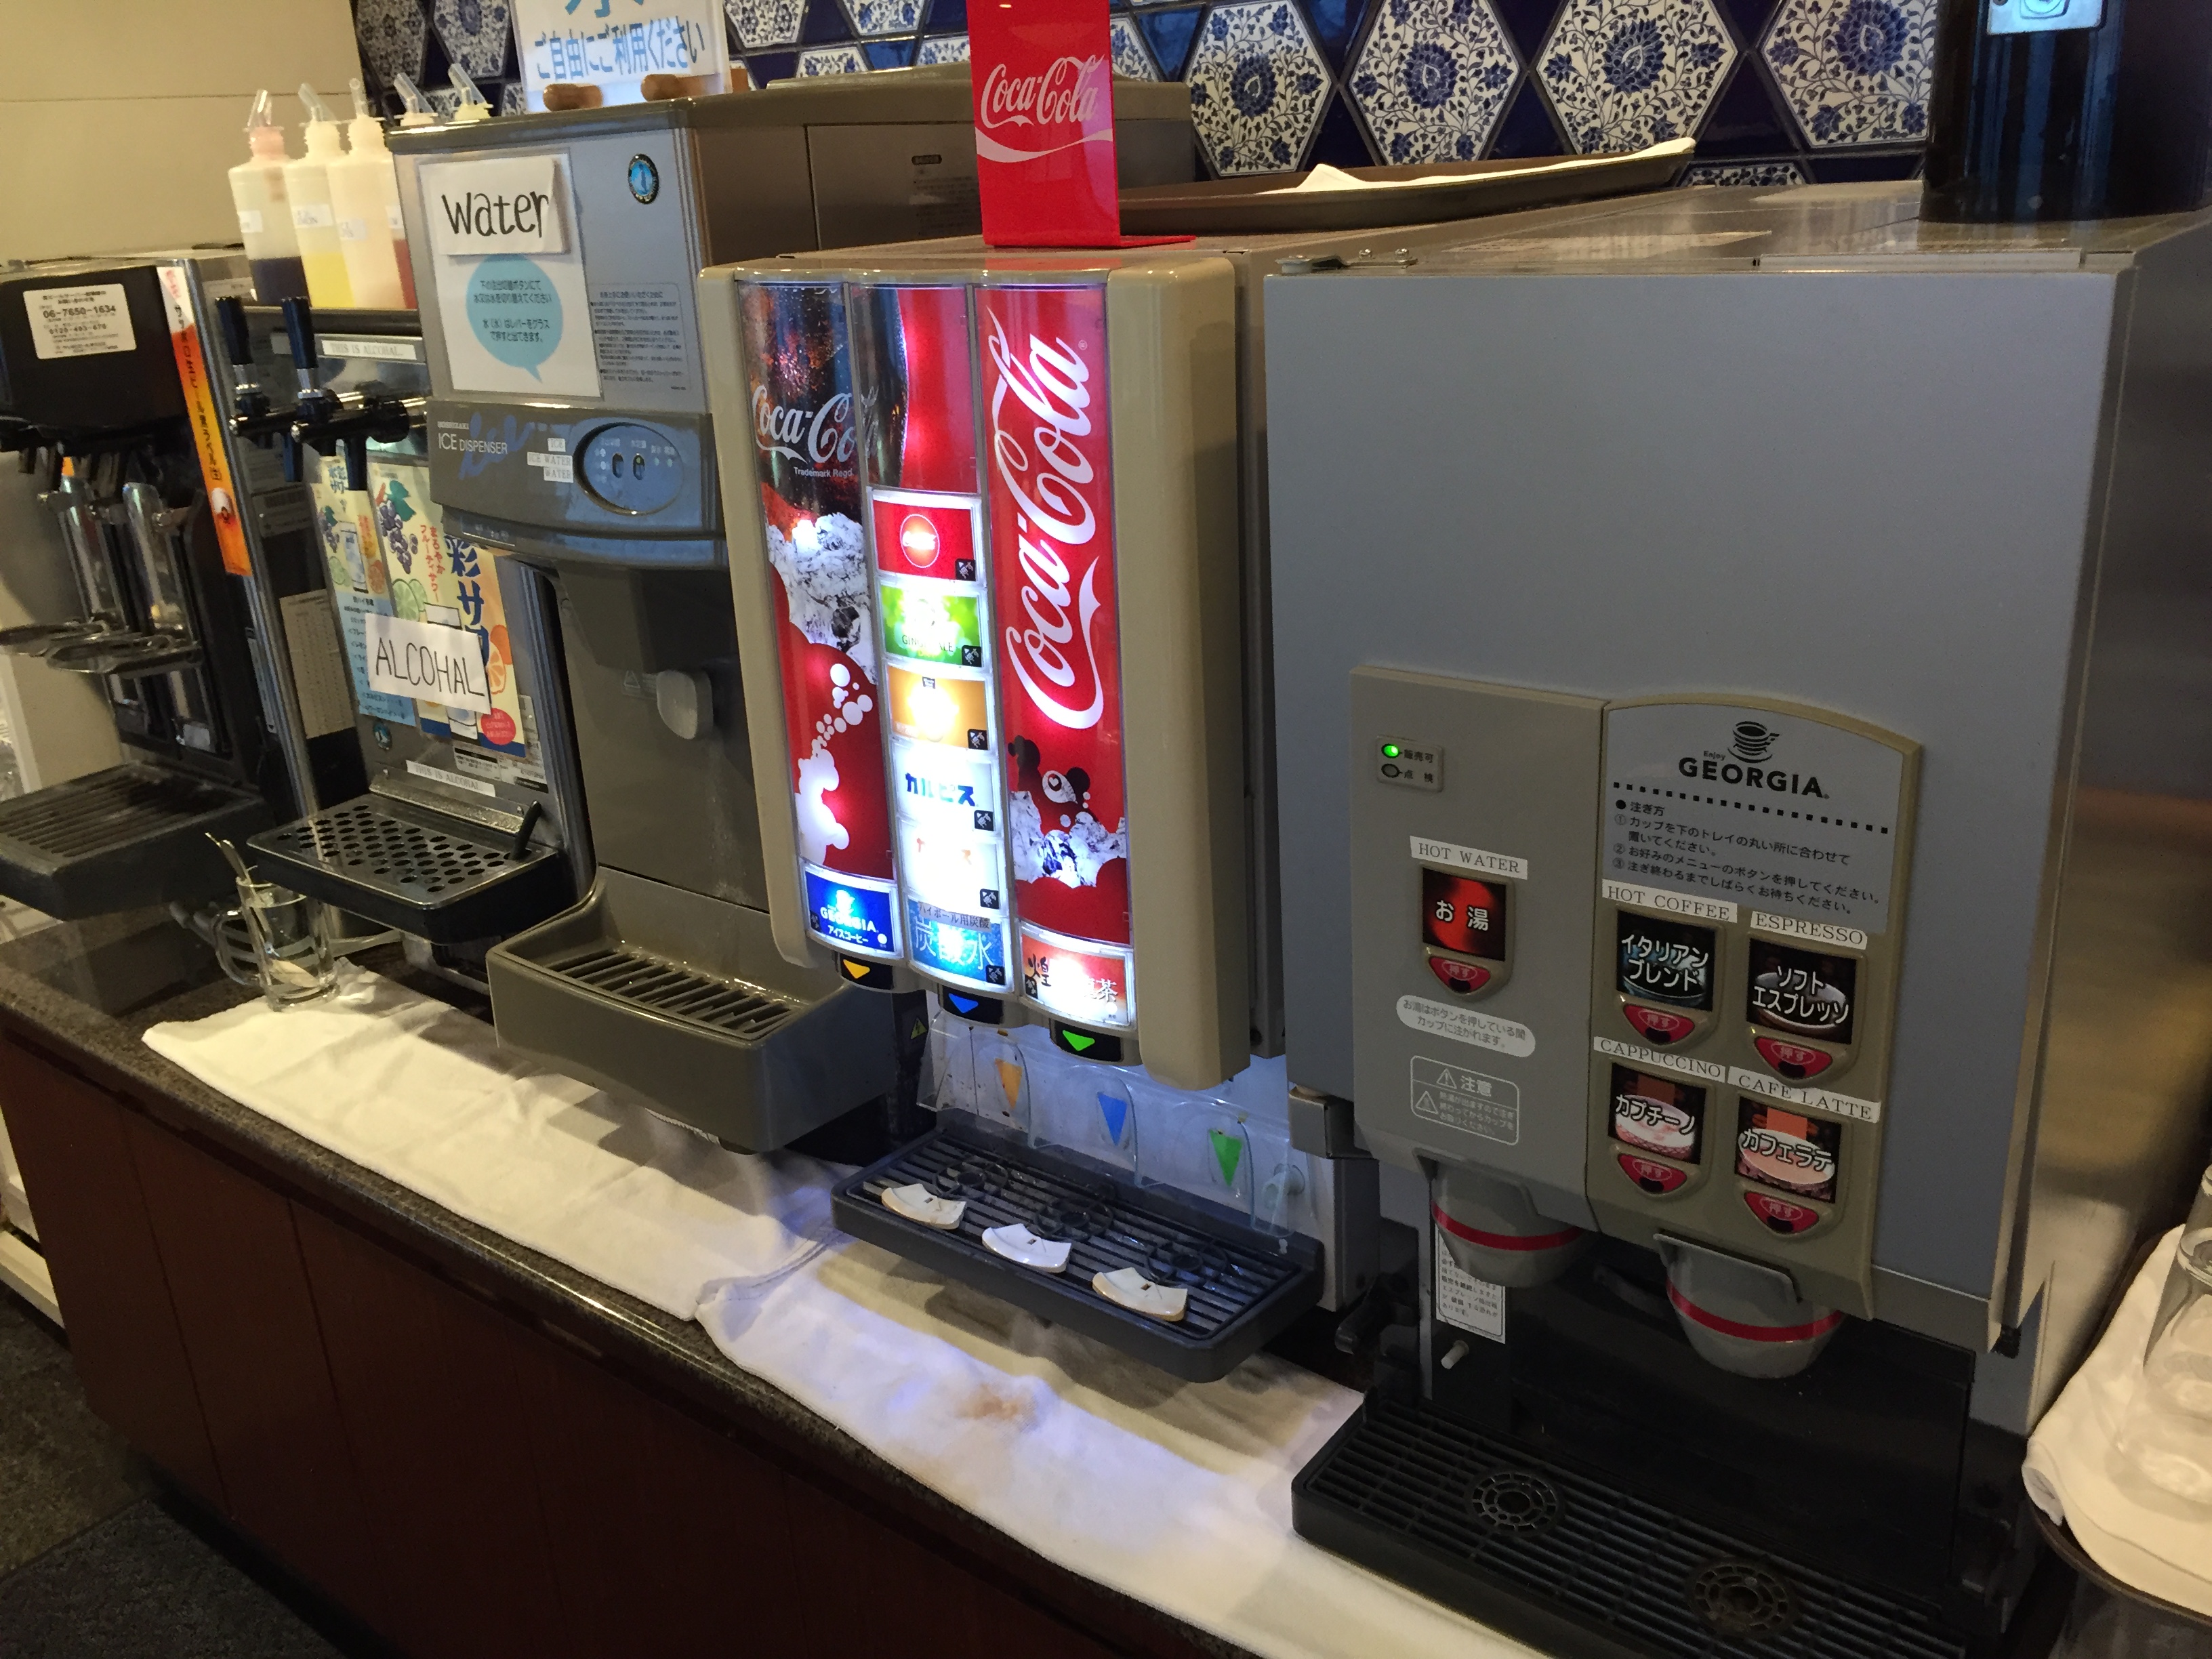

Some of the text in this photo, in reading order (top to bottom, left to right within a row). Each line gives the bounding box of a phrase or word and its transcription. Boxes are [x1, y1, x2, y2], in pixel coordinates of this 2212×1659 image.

[535, 16, 705, 80] ご自由にご利用ください
[981, 54, 1105, 129] Coca-Cola
[441, 190, 550, 239] Water
[438, 432, 508, 455] ICE DISPENSER
[528, 453, 572, 466] ICE WATER
[550, 438, 565, 449] ICE
[545, 468, 572, 479] WATER
[794, 466, 831, 477] Trademark
[987, 304, 1104, 729] Coca-Cola
[375, 636, 485, 697] ALCOHAL
[1703, 750, 1726, 761] Enjoy
[1678, 757, 1825, 799] GEORGIA
[1630, 801, 1664, 816] 注ぎ方
[1418, 842, 1520, 874] HOT WATER
[1629, 816, 1851, 866] カップを下のトレイの丸い所に合わせて
[1627, 860, 1851, 914] 注ぎ終わるまでしばらくお待ちください。
[1629, 846, 1879, 904] お好みのメニューのボタンを押してください。
[1435, 899, 1490, 932] お湯
[1607, 885, 1731, 922] HOT COFFEE
[827, 925, 869, 944] アイスコーヒー
[1755, 914, 1864, 945] ESPRESSO
[1620, 933, 1710, 970] イタリアン
[1627, 958, 1701, 992] ブレンド
[1777, 964, 1825, 996] ソフト
[1751, 985, 1850, 1024] エスプレッソ
[1600, 1039, 1721, 1079] CAPPUCCINO
[1460, 1075, 1492, 1097] 注意
[1738, 1073, 1872, 1121] CAFE LATTE
[1614, 1093, 1696, 1136] カプチーノ
[1740, 1128, 1835, 1170] カフェラテ
